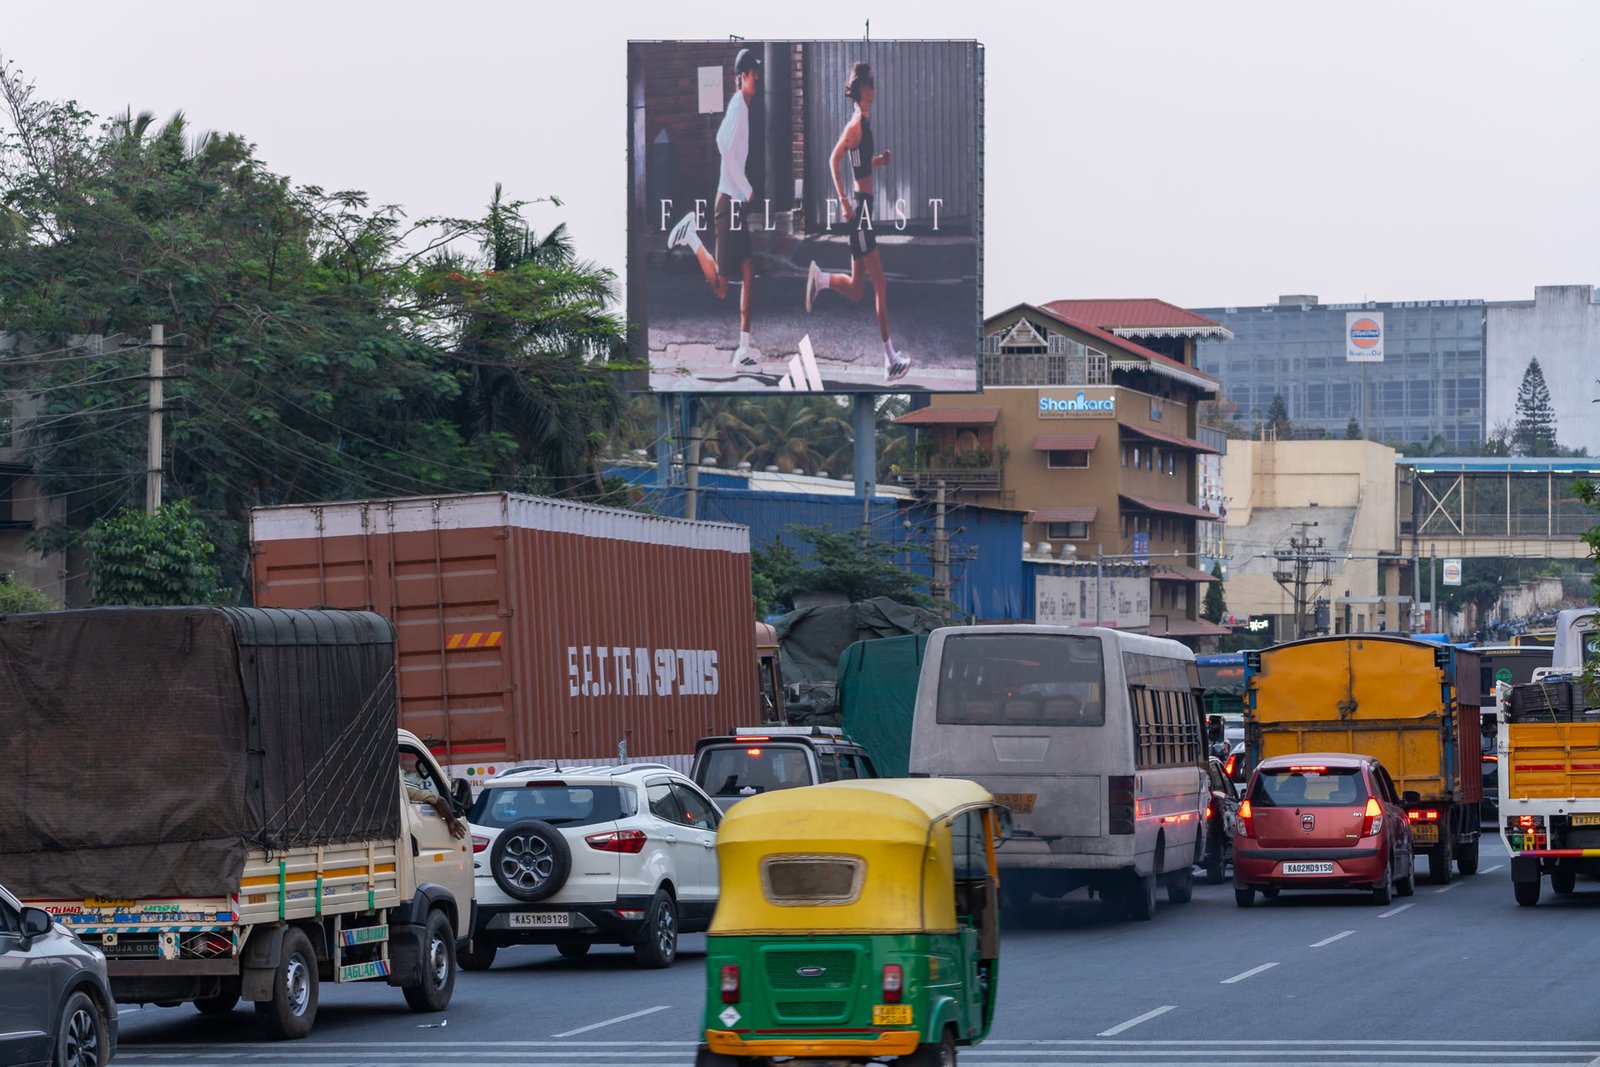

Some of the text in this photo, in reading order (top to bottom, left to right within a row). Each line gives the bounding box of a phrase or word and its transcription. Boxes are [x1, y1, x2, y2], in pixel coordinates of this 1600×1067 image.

[660, 198, 944, 231] FEEL FAST
[1040, 391, 1114, 411] Shankara
[341, 963, 376, 980] JAGUAR
